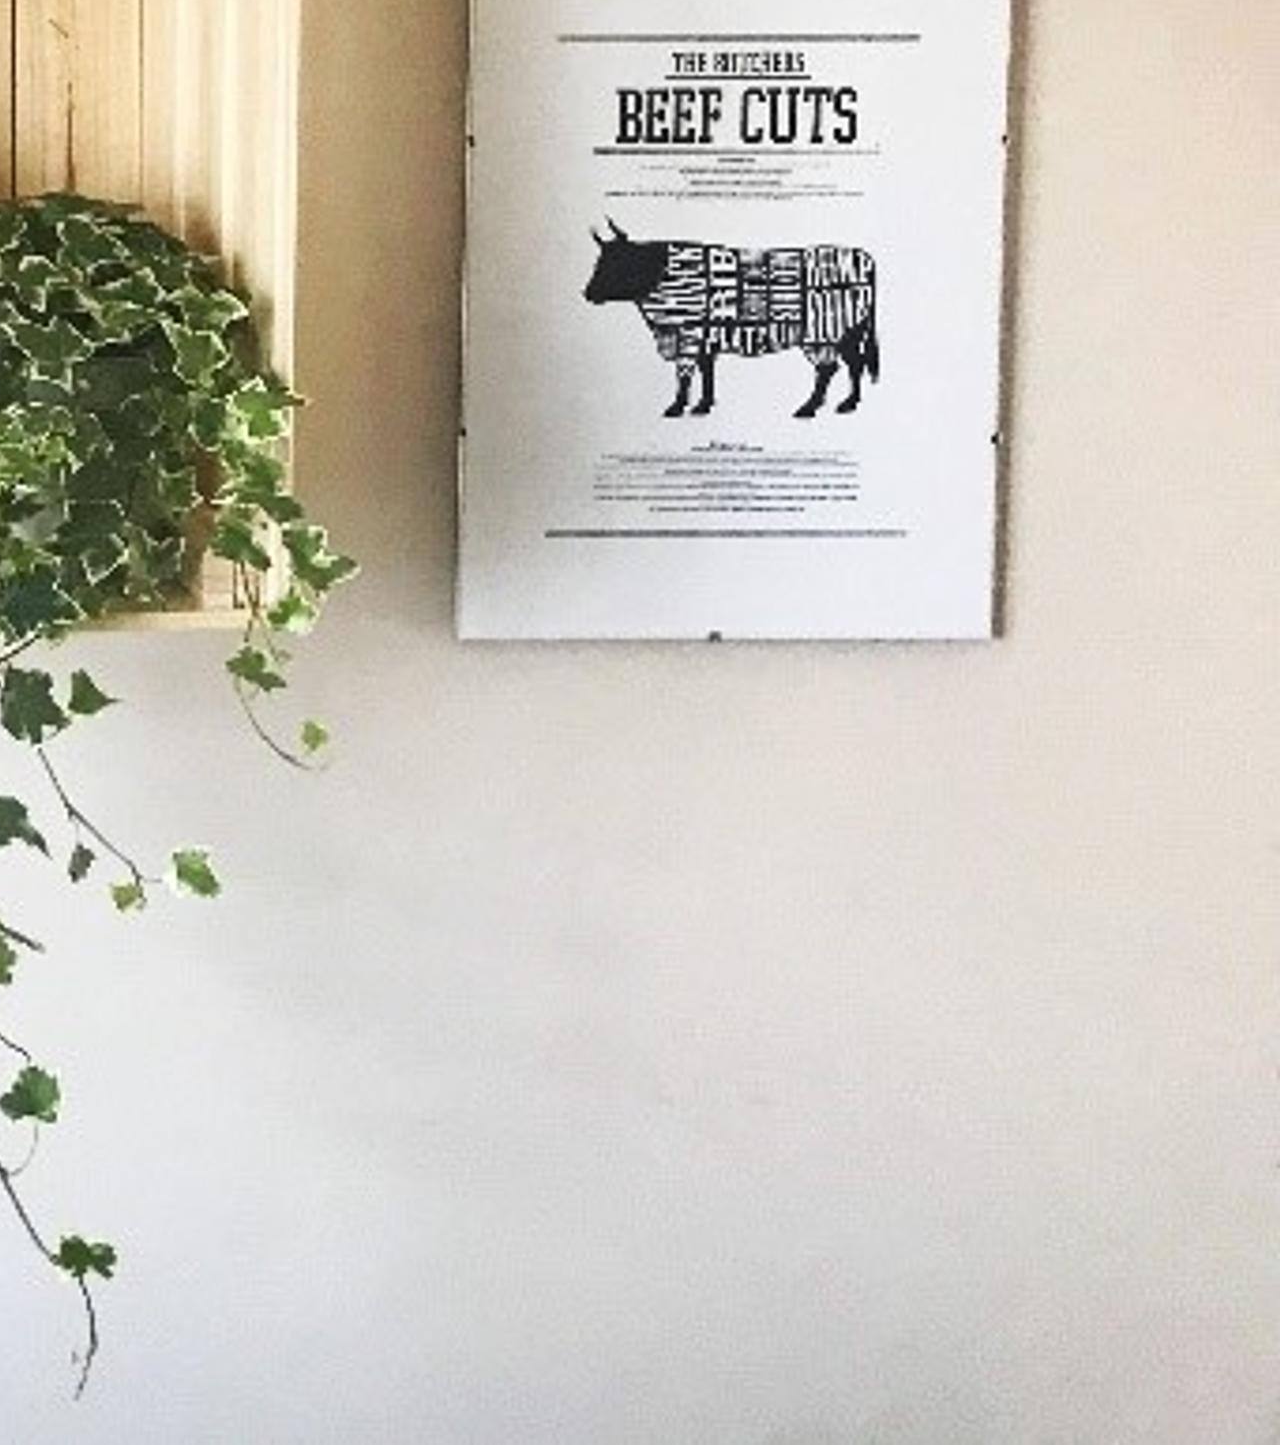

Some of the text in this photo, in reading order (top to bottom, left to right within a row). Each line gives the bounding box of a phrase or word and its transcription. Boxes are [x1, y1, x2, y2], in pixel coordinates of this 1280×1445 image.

[672, 52, 707, 72] THE
[616, 87, 857, 144] BEEF CUTS
[709, 248, 738, 321] RIB
